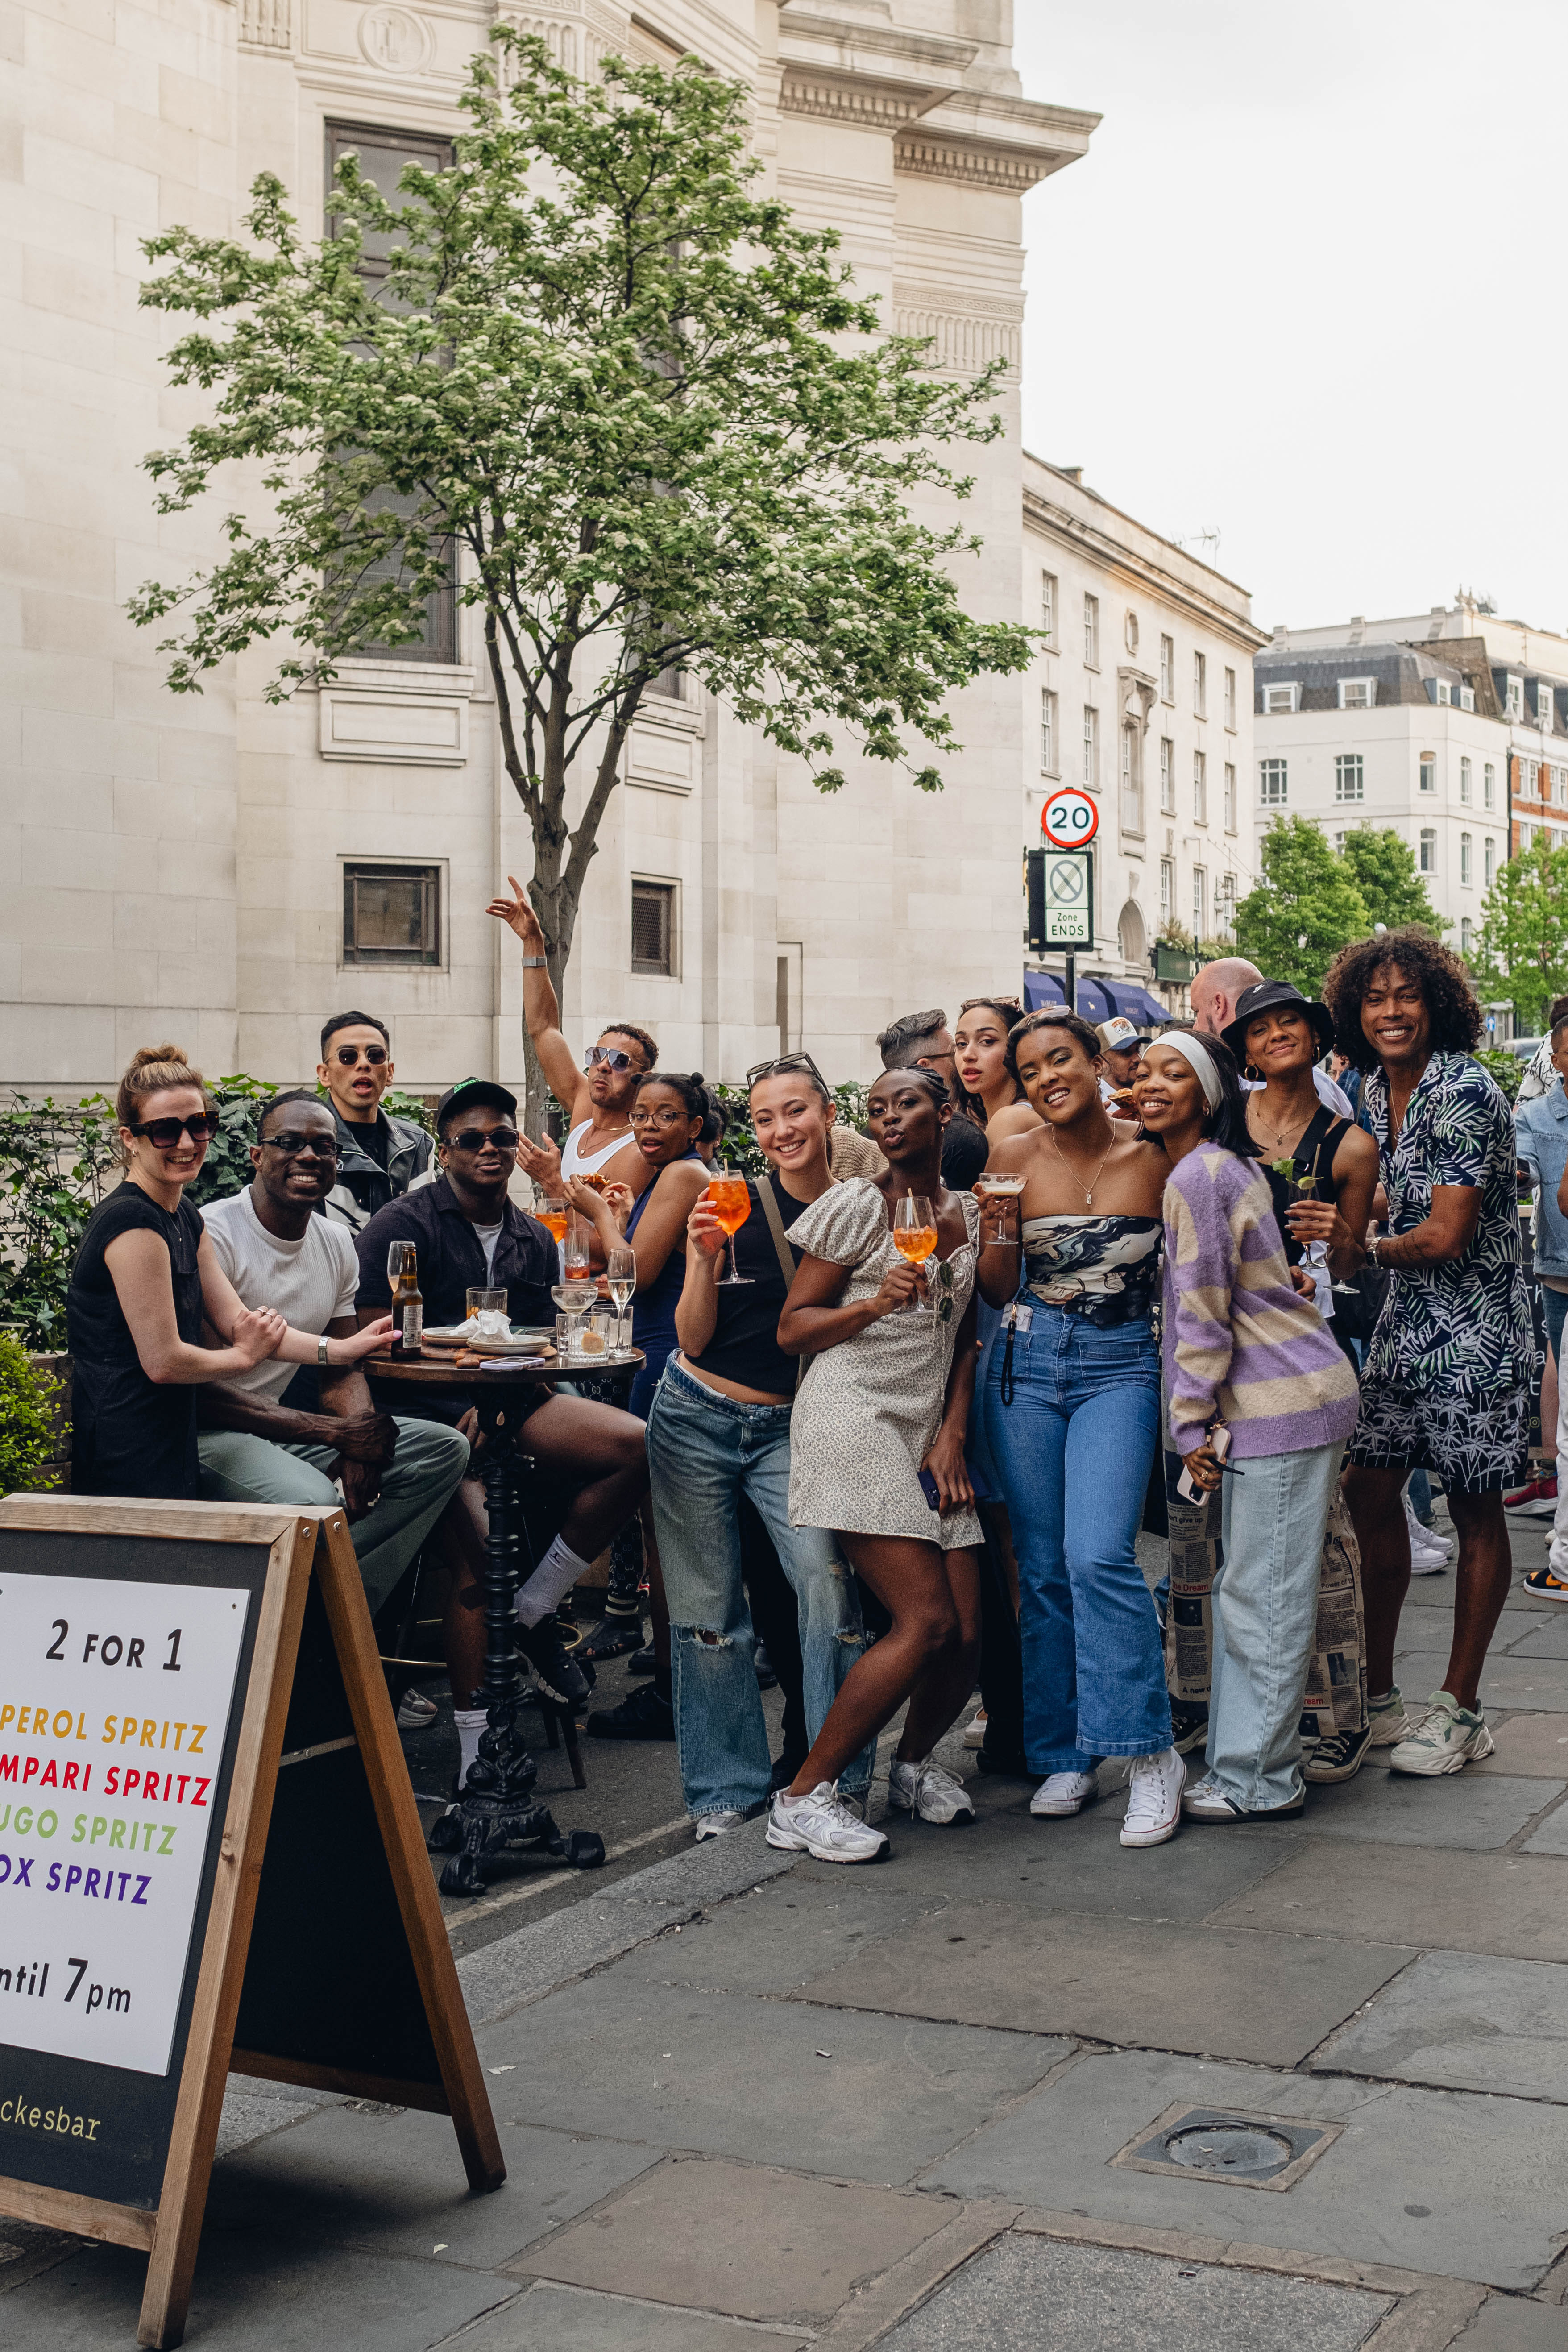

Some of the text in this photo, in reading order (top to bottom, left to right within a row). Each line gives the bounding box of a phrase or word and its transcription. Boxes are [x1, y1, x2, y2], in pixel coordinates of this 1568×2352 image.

[1052, 807, 1090, 829] 20
[1052, 925, 1084, 936] ENDS
[1057, 913, 1078, 921] Zone
[1321, 1580, 1340, 1589] Power
[46, 1619, 182, 1671] 2 FOR 1
[0, 1704, 208, 1753] PEROL SPRITZ
[0, 1754, 212, 1807] MPARI SPRITZ
[71, 1813, 178, 1855] SPRITZ
[46, 1863, 152, 1904] SPRITZ
[0, 2095, 100, 2141] ckesbar
